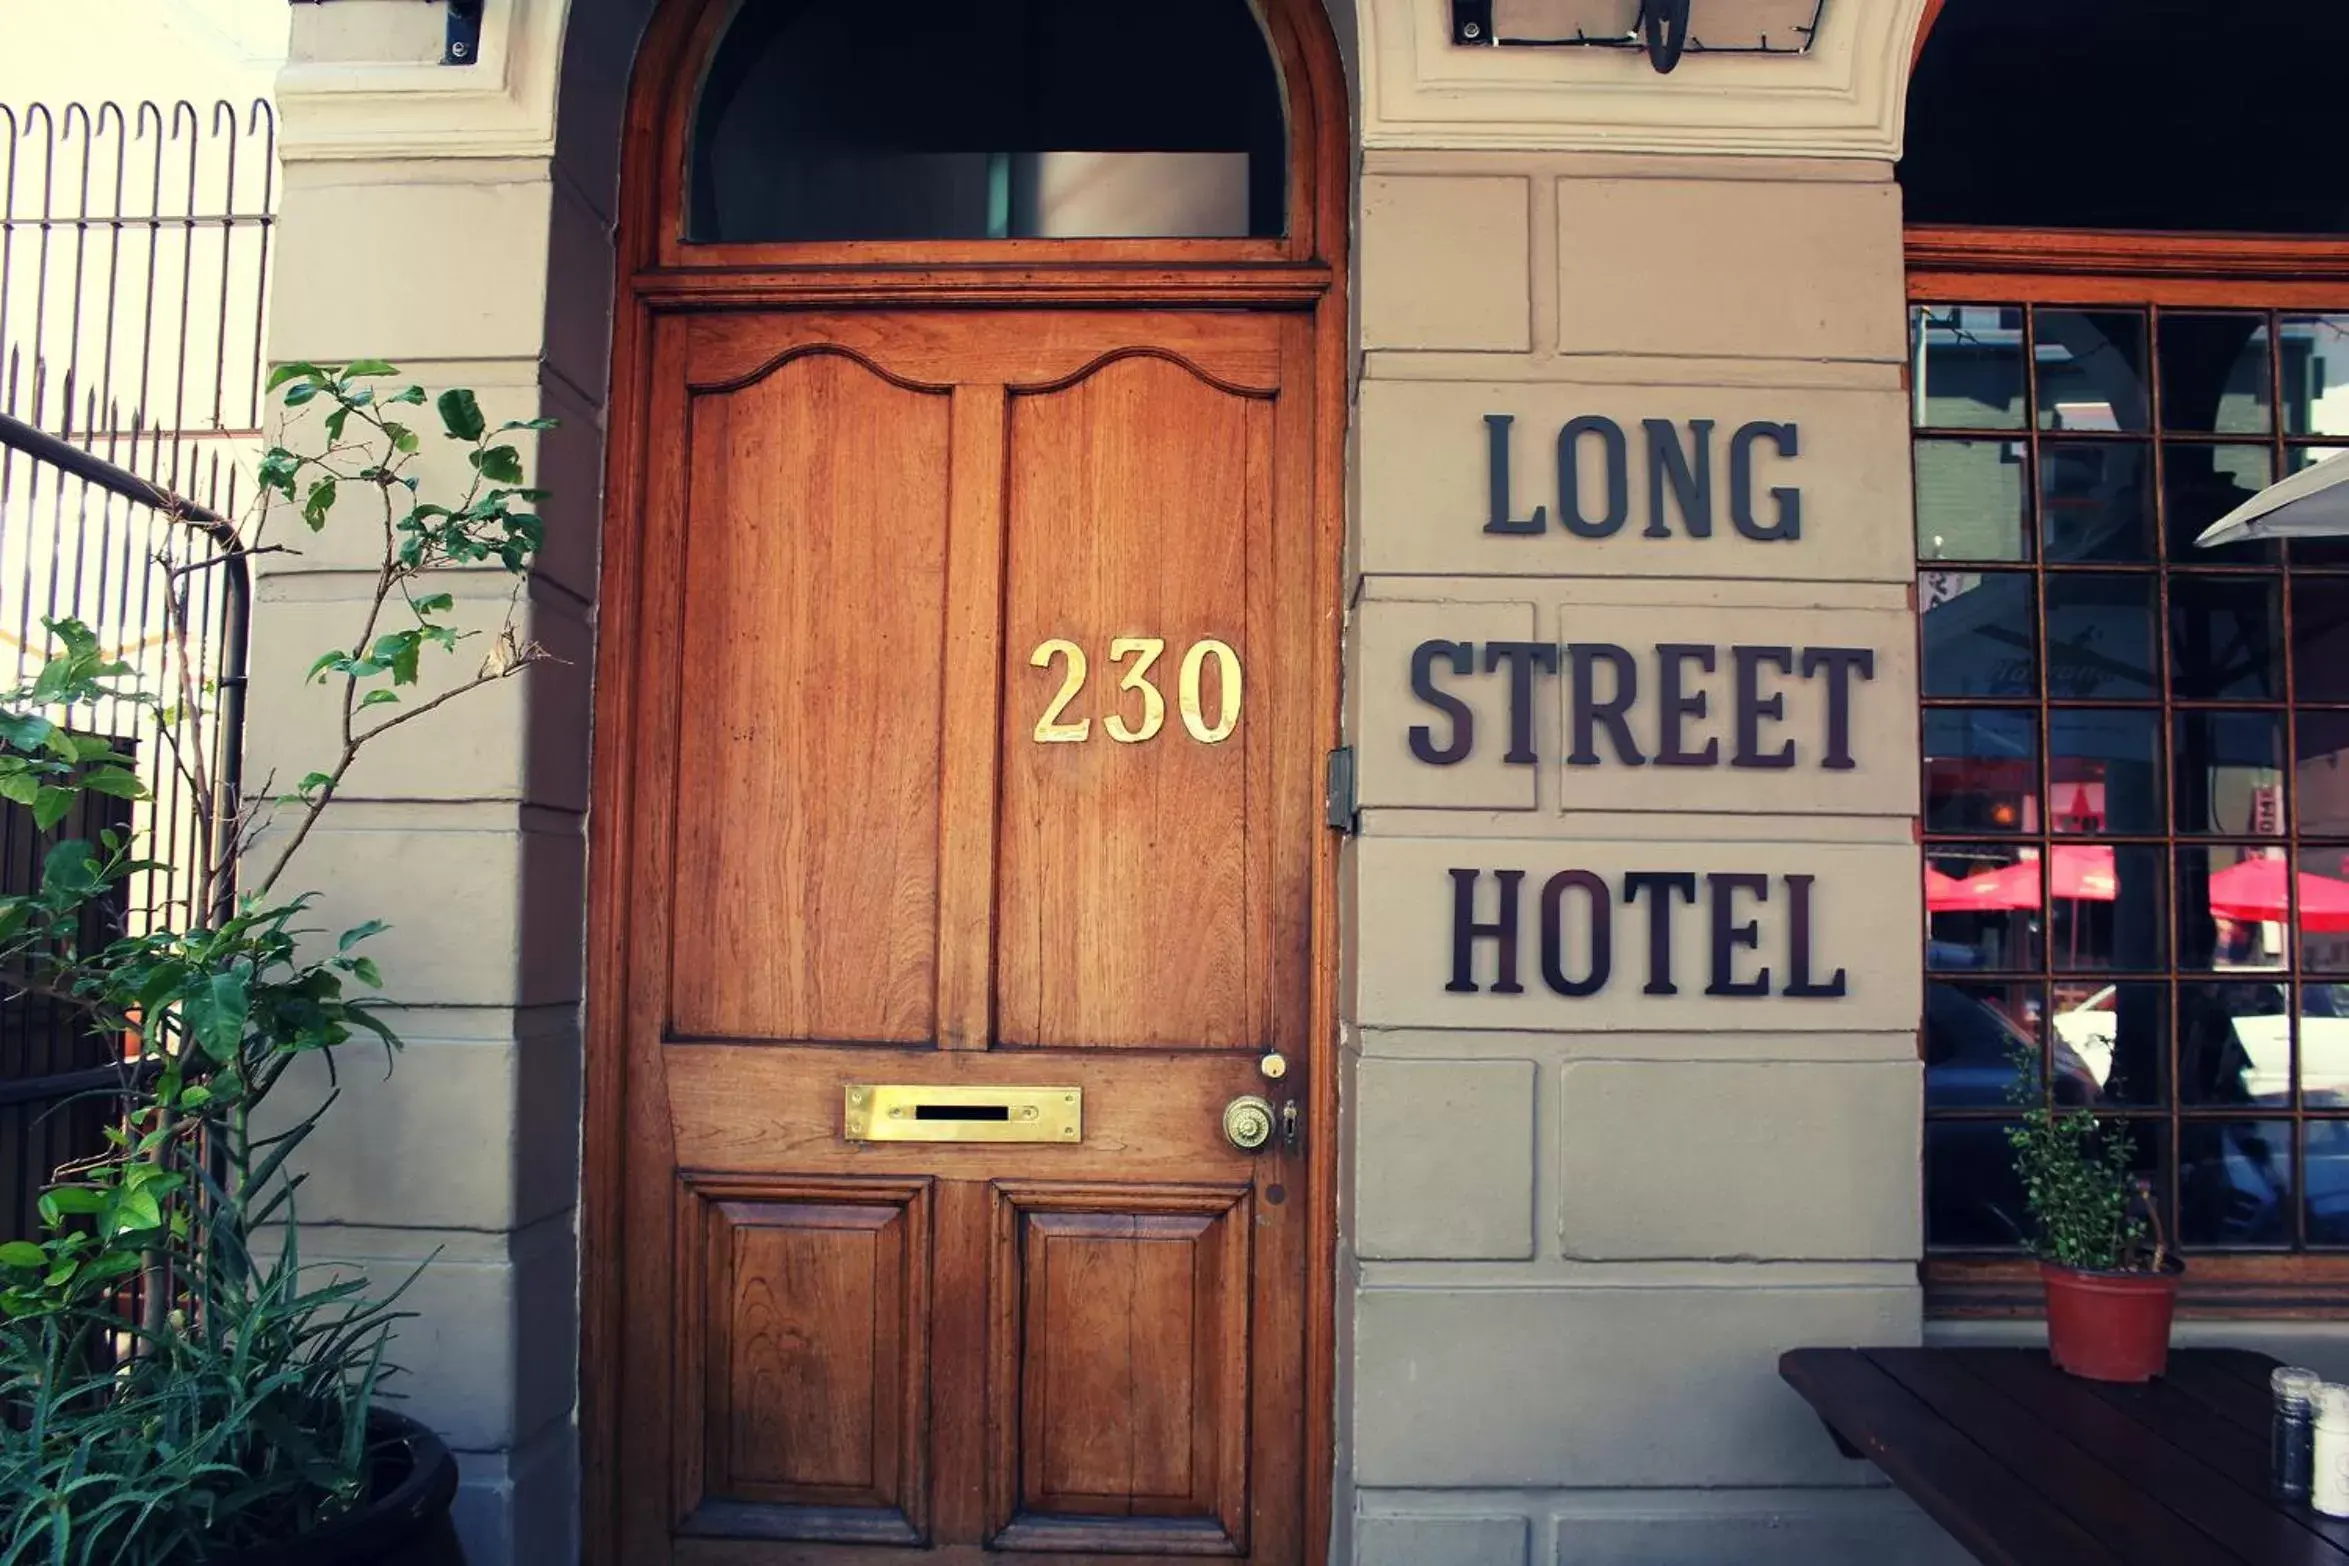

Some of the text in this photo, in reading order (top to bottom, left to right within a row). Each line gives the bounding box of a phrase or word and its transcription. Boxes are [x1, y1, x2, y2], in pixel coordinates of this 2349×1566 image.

[1482, 413, 1801, 540] LONG
[1029, 637, 1243, 744] 230
[1408, 638, 1874, 769] STREET
[1444, 867, 1847, 997] HOTEL
